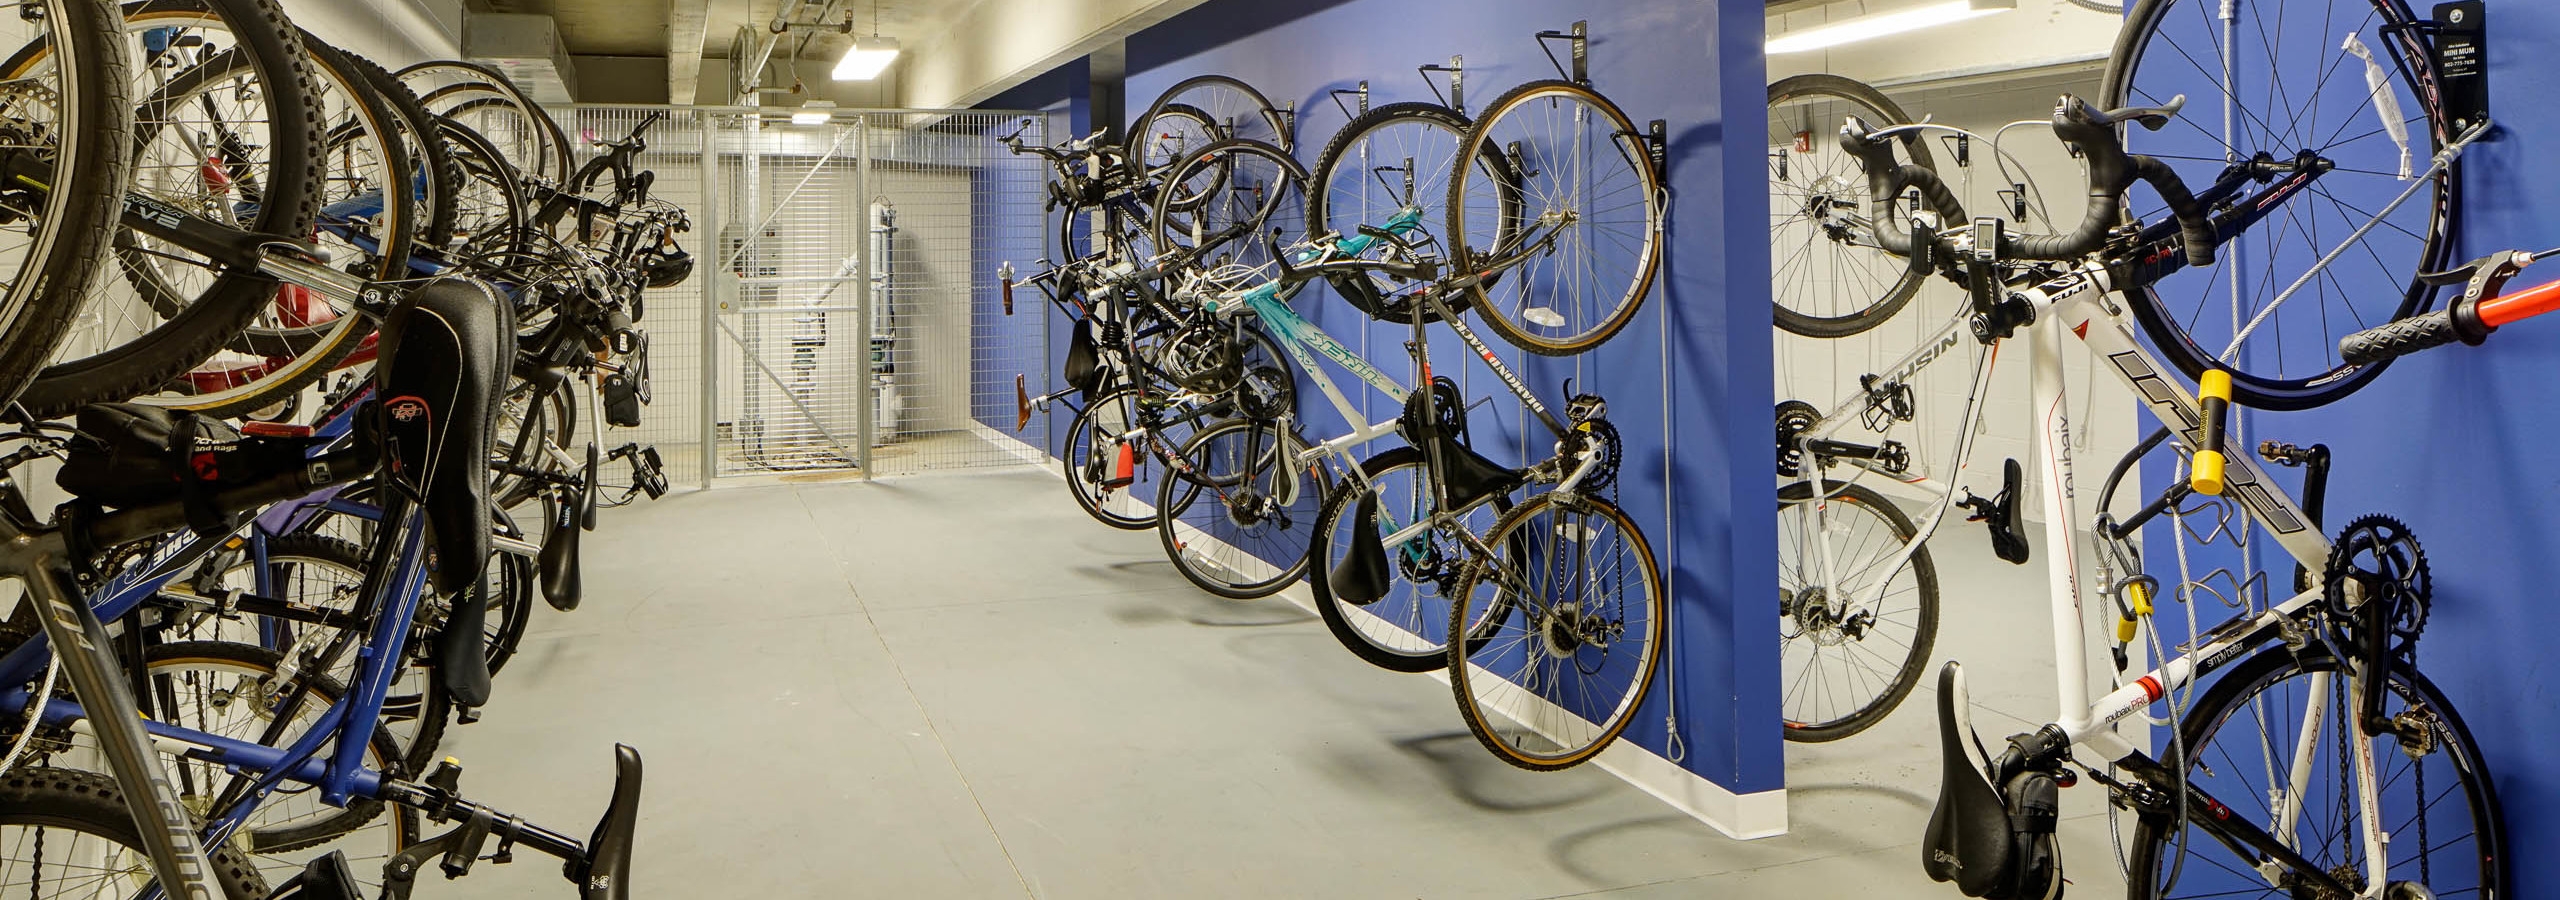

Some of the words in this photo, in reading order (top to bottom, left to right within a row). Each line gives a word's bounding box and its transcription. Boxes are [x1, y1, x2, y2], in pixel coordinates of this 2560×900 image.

[2443, 49, 2458, 57] MINI
[2458, 46, 2475, 55] MUM
[2256, 172, 2308, 212] FUJI
[2050, 283, 2088, 305] FUJI
[1451, 319, 1491, 357] BACK
[1305, 332, 1379, 386] TREK
[1488, 356, 1545, 414] DIAMOND
[2104, 705, 2132, 724] roubaix
[2130, 694, 2149, 711] PRO
